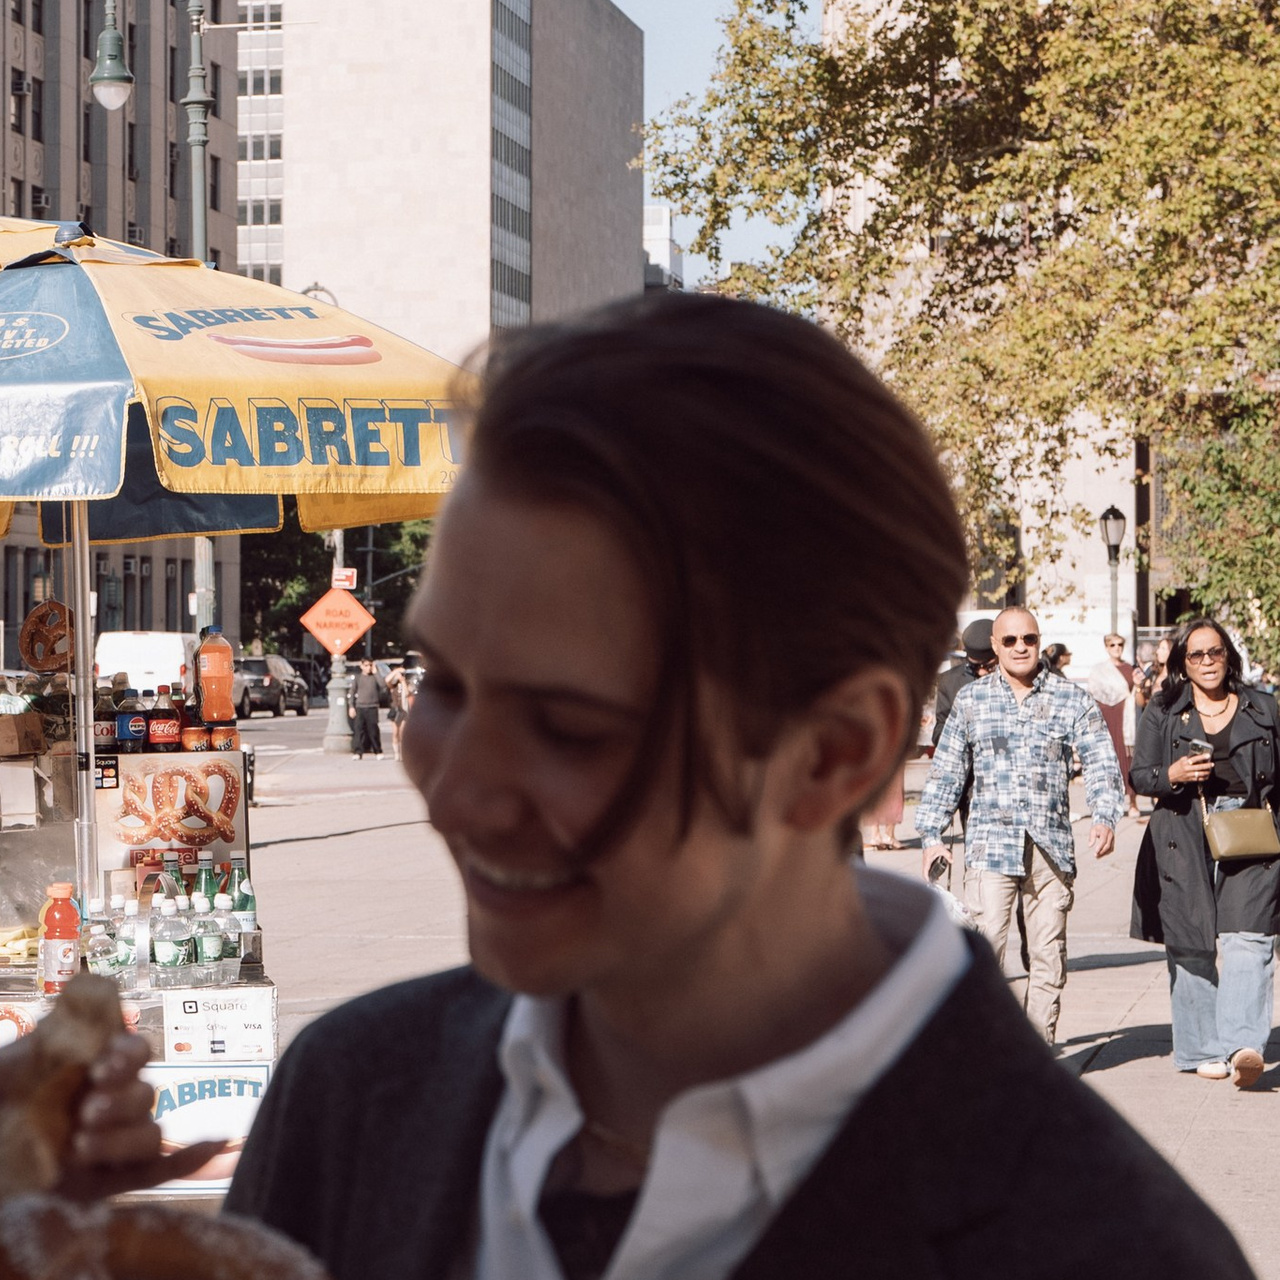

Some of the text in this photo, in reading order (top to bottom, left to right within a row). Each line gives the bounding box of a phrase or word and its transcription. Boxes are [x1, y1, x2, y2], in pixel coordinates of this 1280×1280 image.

[128, 306, 320, 341] SABRETT
[8, 435, 62, 458] ROLL
[325, 609, 351, 618] ROAD
[316, 622, 360, 630] NARROWS
[96, 758, 117, 766] Square
[202, 1000, 248, 1013] Square
[150, 1076, 263, 1121] ABRETT
